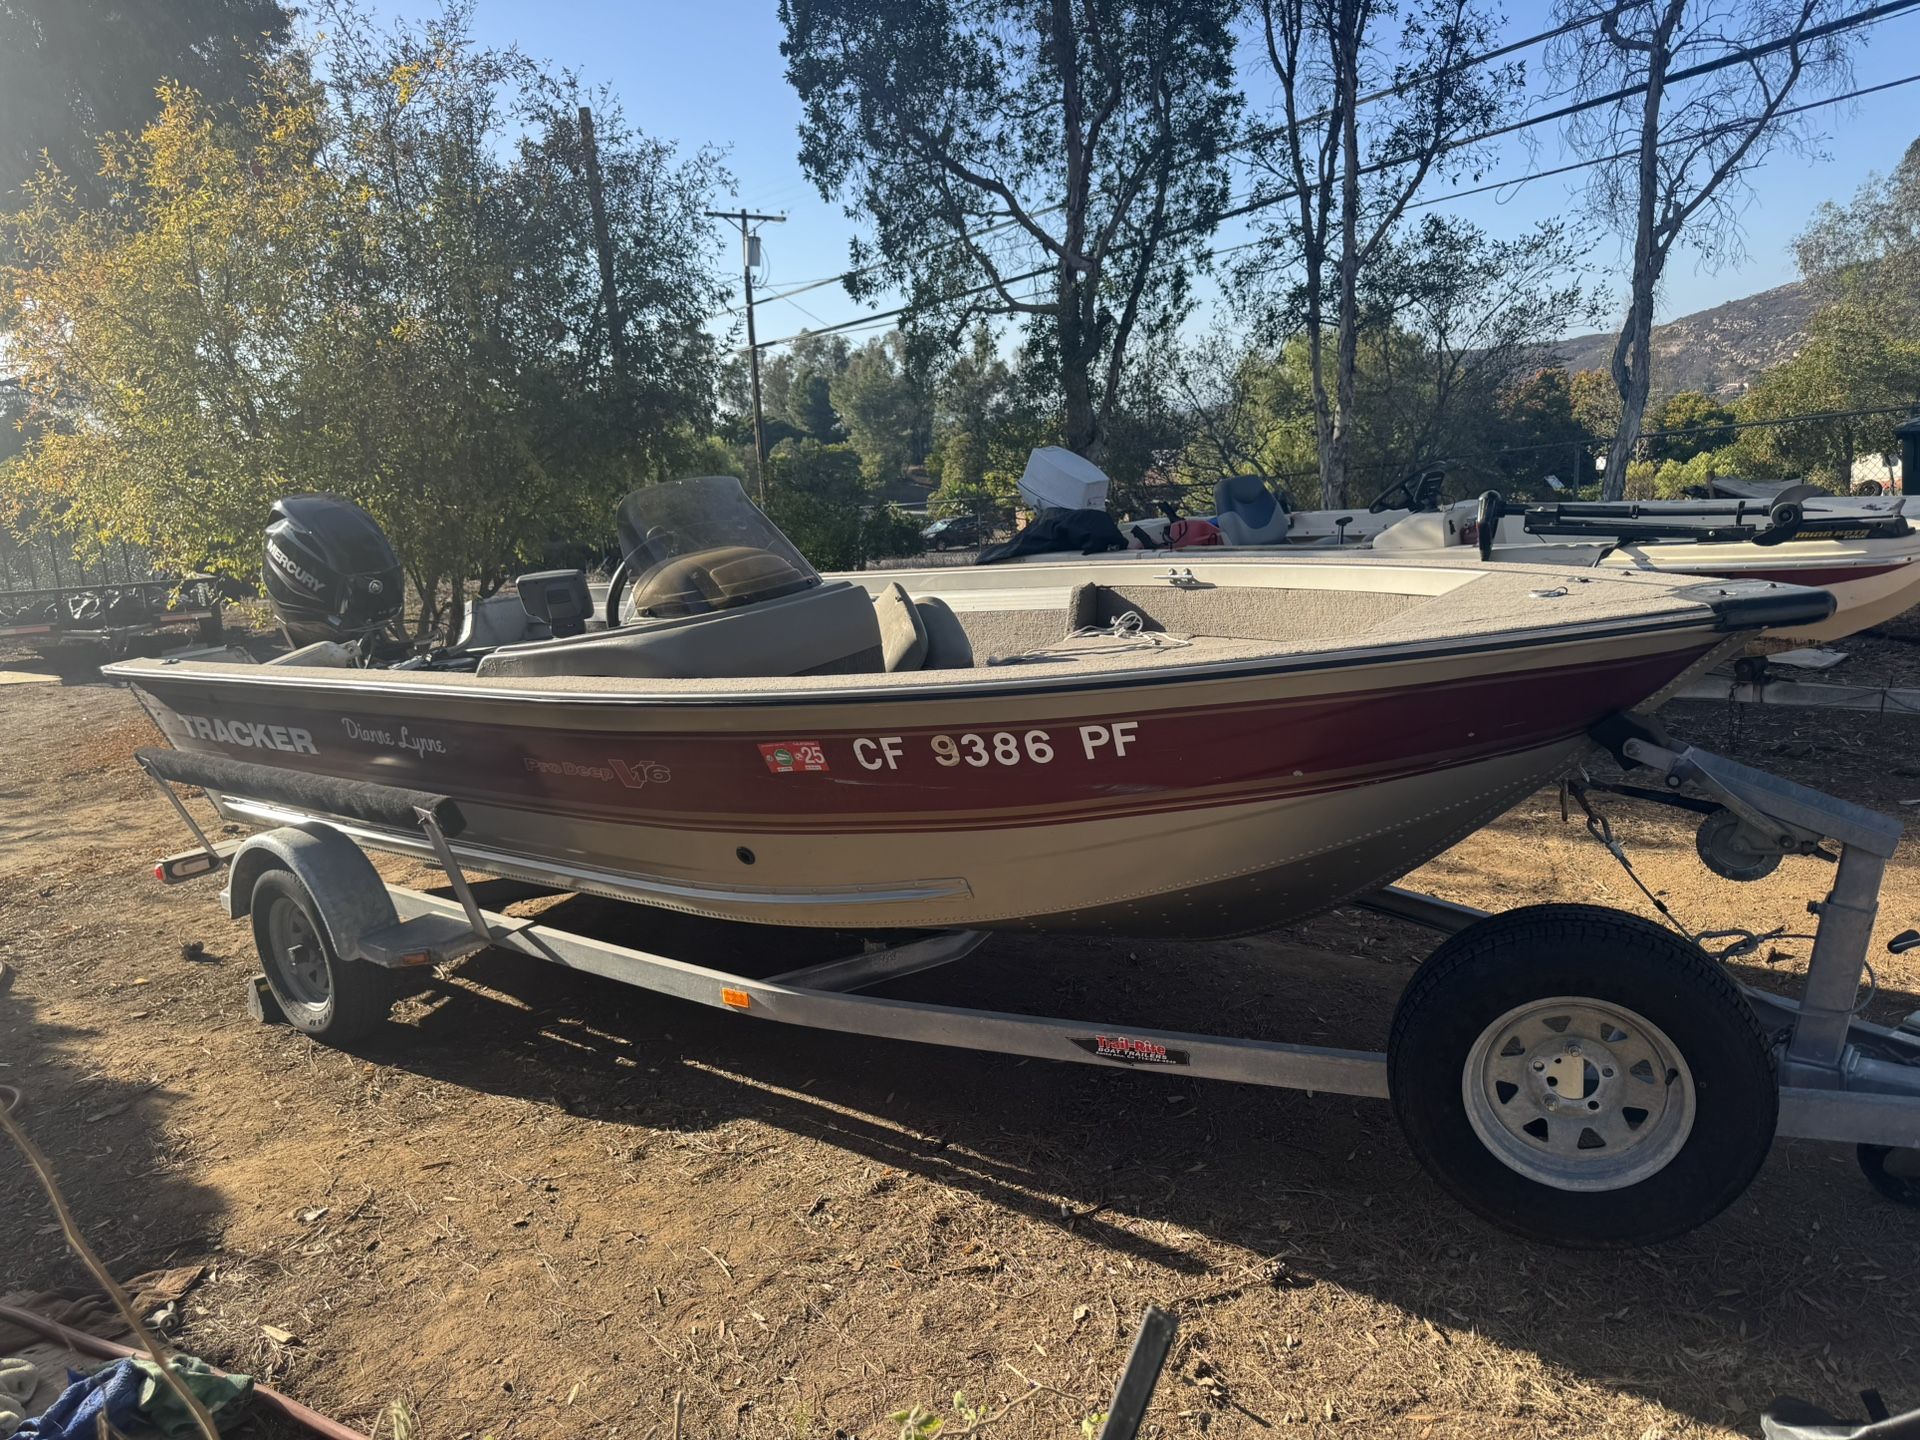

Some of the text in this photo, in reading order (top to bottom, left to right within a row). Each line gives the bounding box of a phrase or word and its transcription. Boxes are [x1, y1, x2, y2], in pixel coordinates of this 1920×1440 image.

[266, 538, 326, 593] MERCURY
[176, 712, 320, 755] TRACKER
[341, 717, 447, 759] Dianne Lynne
[852, 721, 1139, 770] CF 9386 PF
[523, 757, 563, 774] Pro
[561, 761, 614, 782] Deep
[800, 746, 826, 764] 25
[1096, 1035, 1166, 1056] Trail-Rite
[1124, 1050, 1167, 1060] TRAILERS
